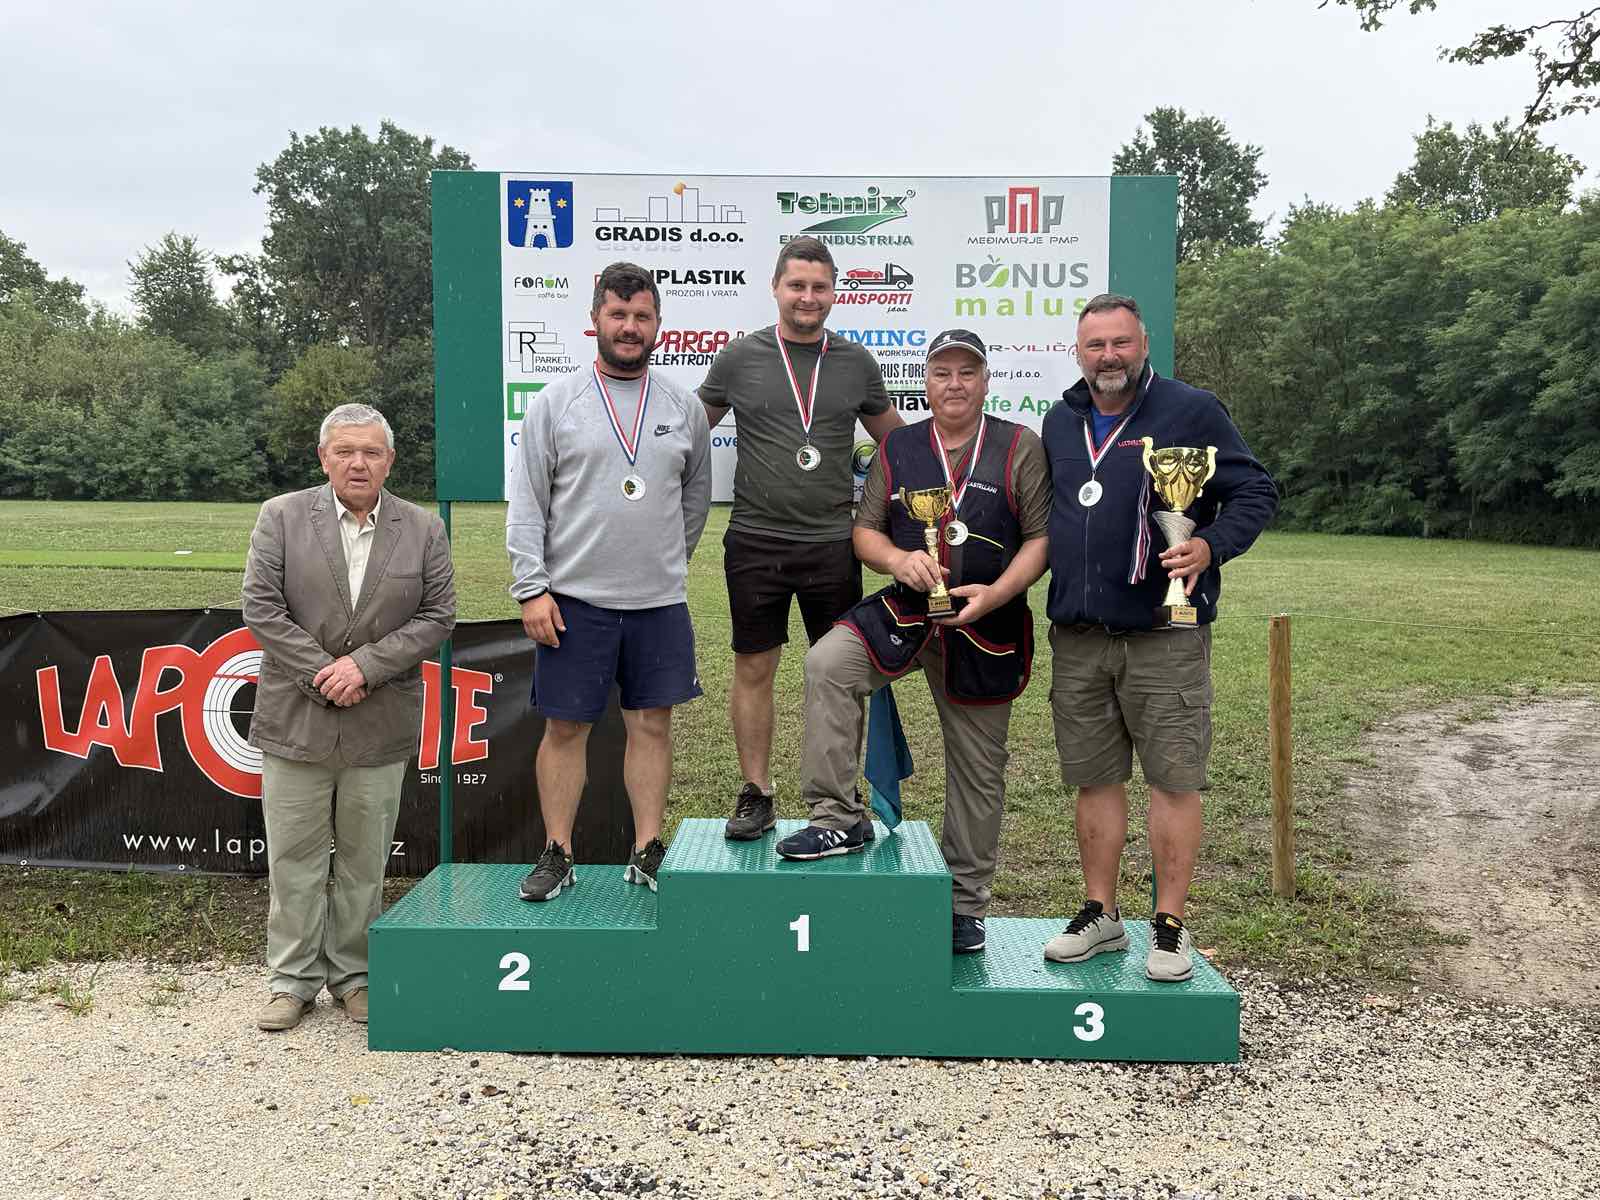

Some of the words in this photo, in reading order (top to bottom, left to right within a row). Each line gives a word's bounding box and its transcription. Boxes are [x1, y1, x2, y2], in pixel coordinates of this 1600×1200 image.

[776, 185, 908, 214] Tehnix
[595, 226, 683, 243] GRADIS
[689, 228, 744, 243] d.o.o.
[819, 234, 913, 246] INDUSTRIJA
[1049, 236, 1079, 245] PMP
[514, 276, 569, 289] FORUM
[650, 269, 746, 285] PLASTIK
[955, 262, 1089, 289] BONUS
[665, 289, 704, 297] PROZORI
[706, 289, 710, 297] I
[712, 289, 739, 297] VRATA
[955, 290, 1088, 317] malus
[519, 331, 537, 354] R
[535, 356, 571, 364] PARKETI
[1018, 395, 1058, 416] Ap
[456, 773, 488, 784] 1927
[789, 914, 810, 952] 1
[498, 952, 531, 991] 2
[1073, 1002, 1105, 1042] 3
